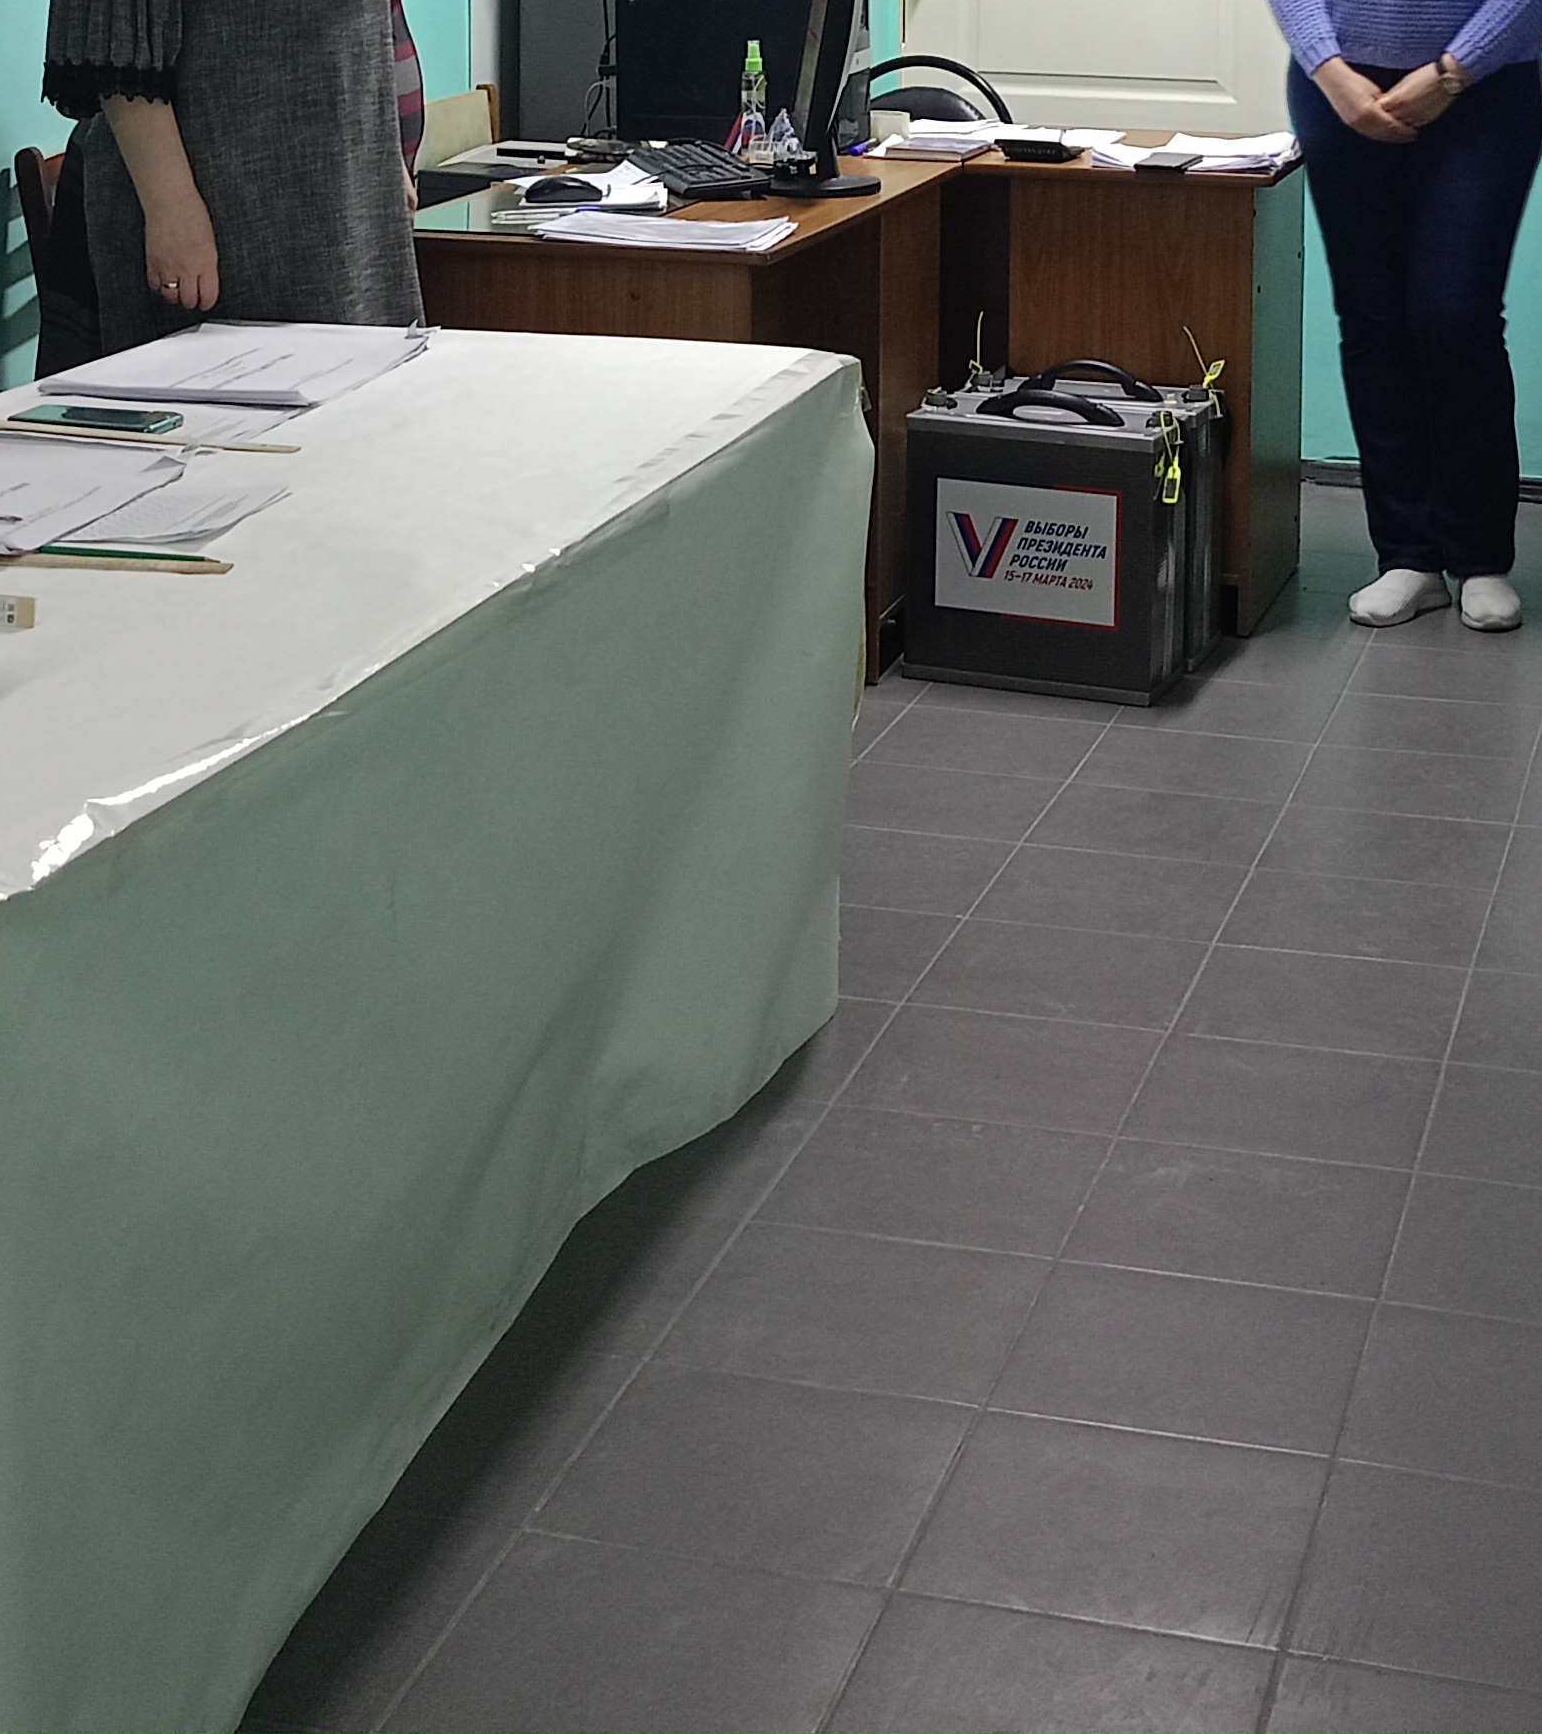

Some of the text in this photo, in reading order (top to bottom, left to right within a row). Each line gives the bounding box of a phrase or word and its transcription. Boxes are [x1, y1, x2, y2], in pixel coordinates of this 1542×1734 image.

[1024, 520, 1089, 540] ВЫБОРЫ
[1016, 537, 1108, 560] ПРЕЗИДЕНТА
[1009, 554, 1069, 572] РОССИИ
[1032, 573, 1068, 588] МАРТА
[1068, 577, 1094, 591] 2024
